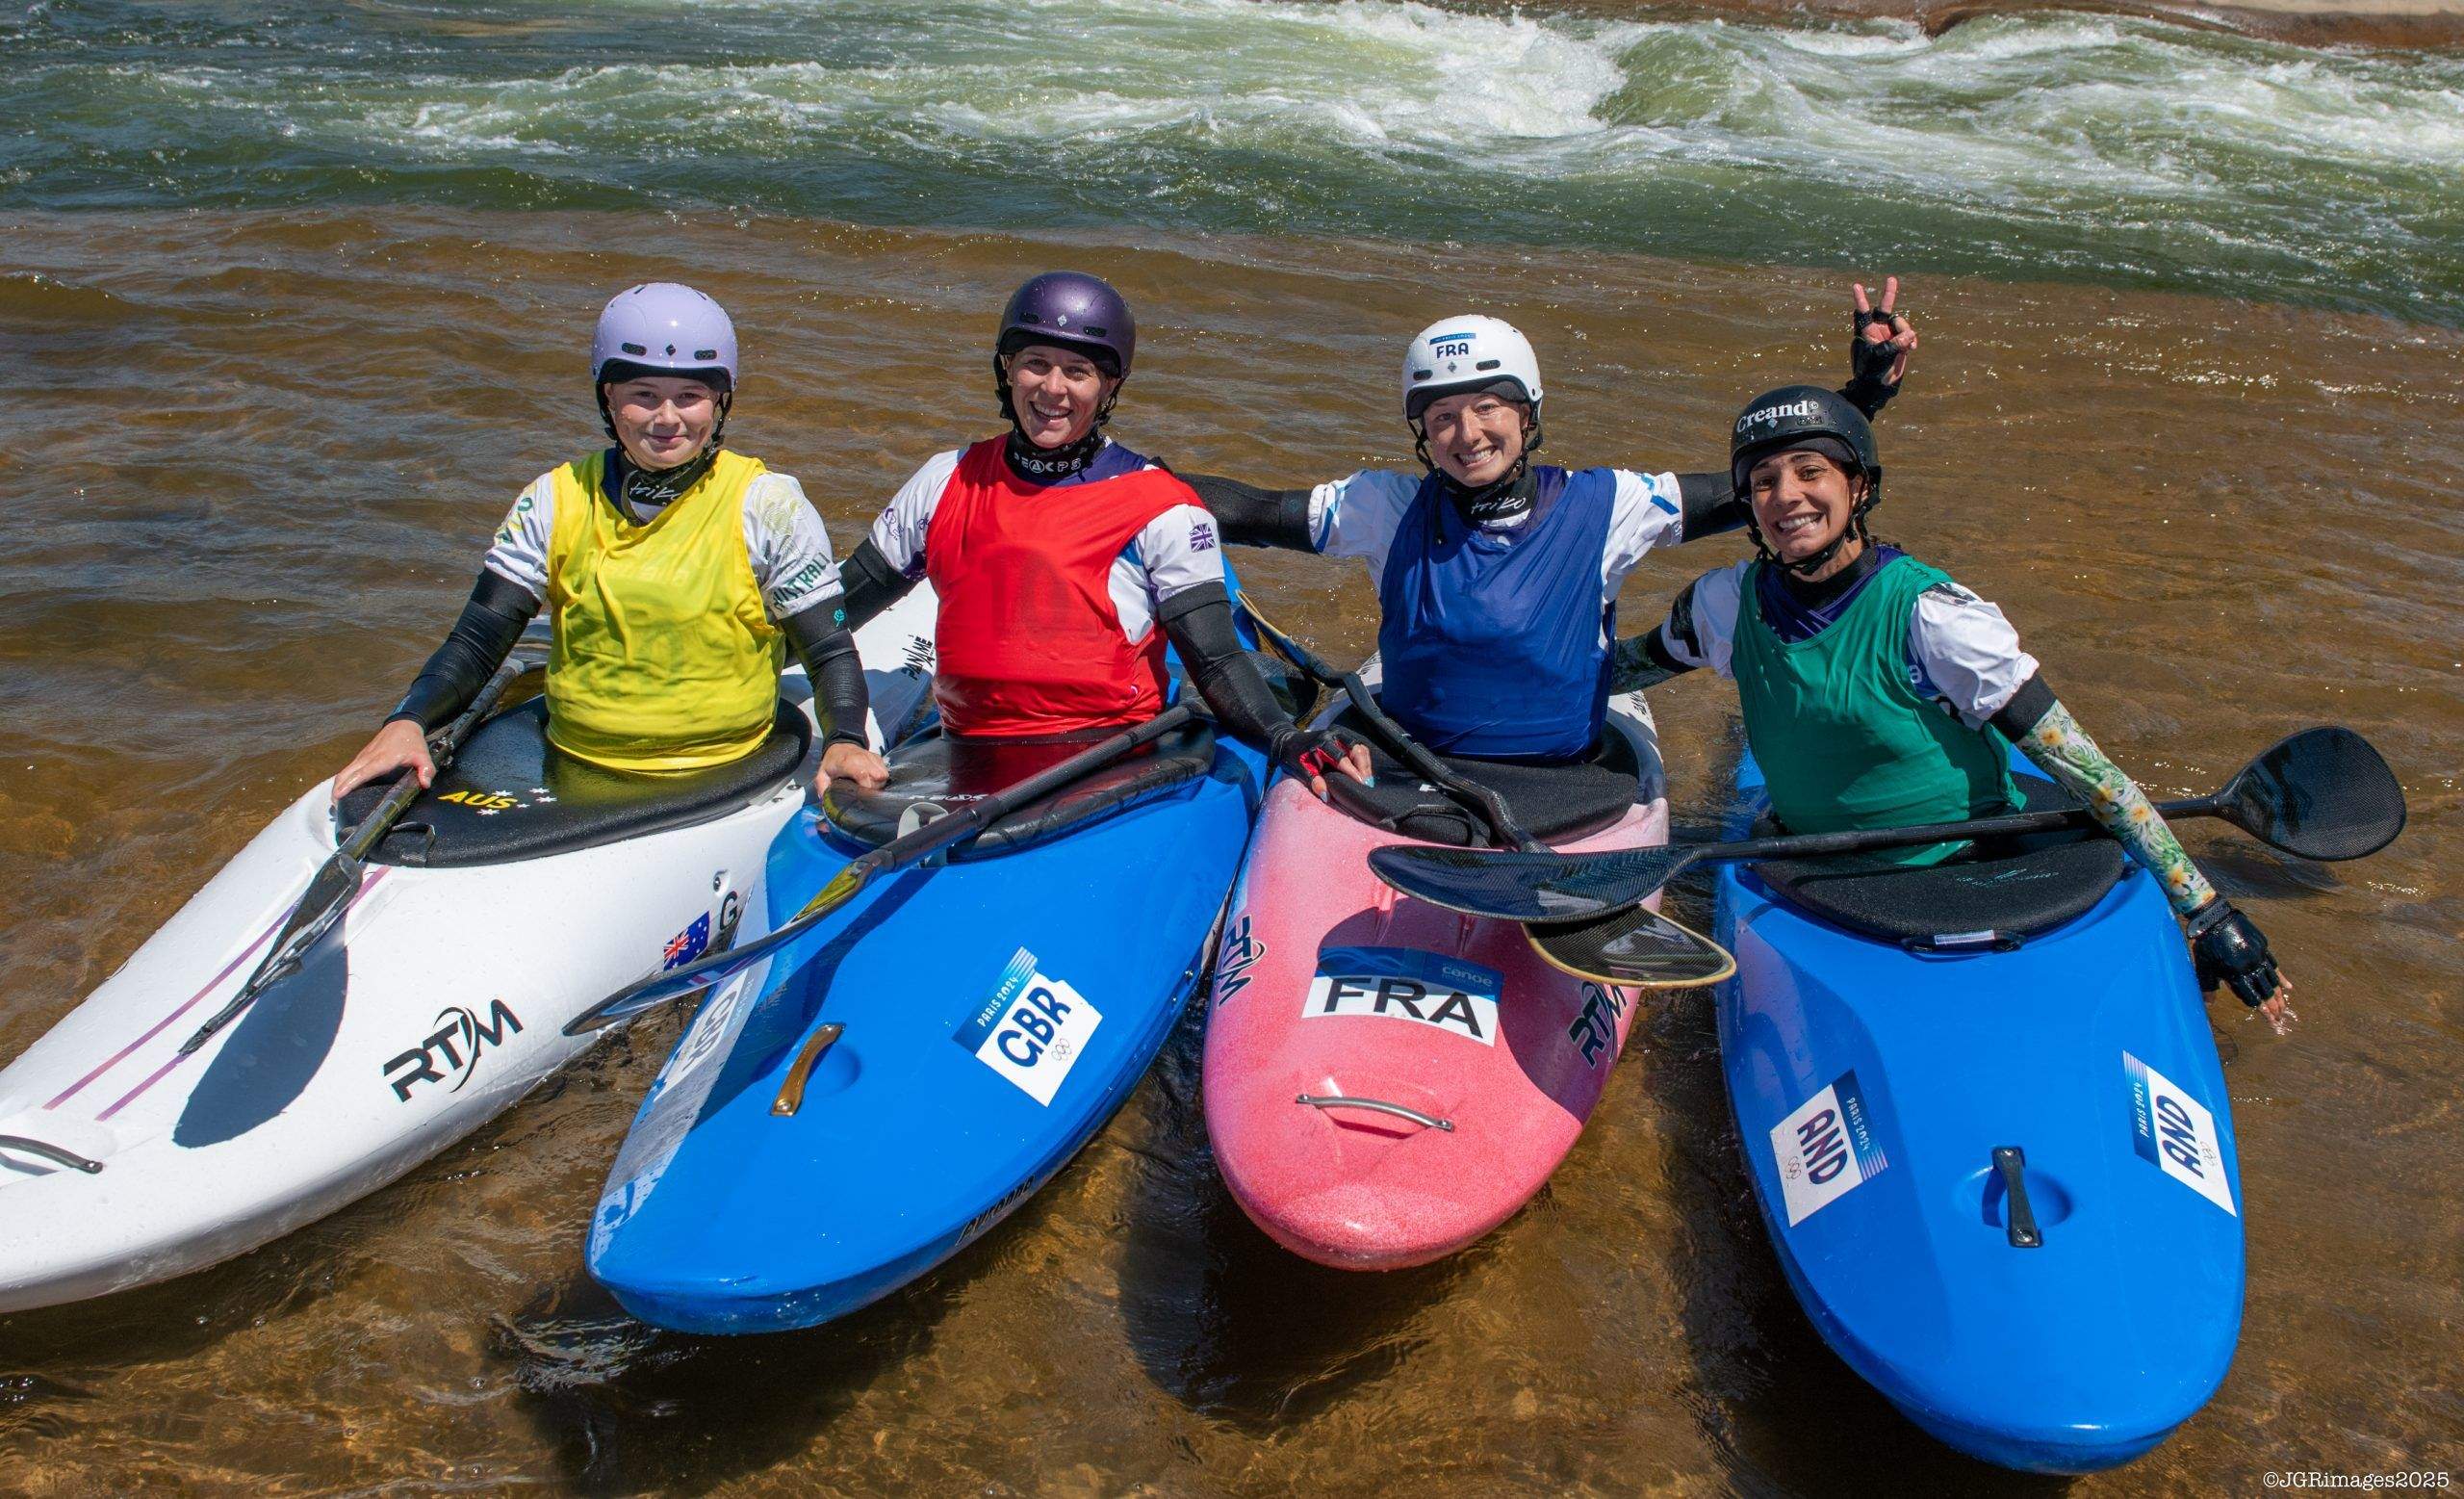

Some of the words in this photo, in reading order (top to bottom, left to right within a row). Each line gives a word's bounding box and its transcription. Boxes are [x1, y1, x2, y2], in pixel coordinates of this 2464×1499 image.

[1436, 342, 1470, 359] FRA
[1735, 400, 1809, 433] Creand
[437, 790, 518, 809] AUS
[976, 998, 1002, 1028] PARIS
[996, 974, 1019, 1001] 2024
[1442, 966, 1494, 987] canoe
[997, 986, 1072, 1068] GBR
[1322, 976, 1484, 1039] FRA
[383, 998, 524, 1103] RTM
[2133, 1080, 2146, 1109] 2024
[1796, 1108, 1848, 1185] AND
[1846, 1097, 1863, 1126] PARIS
[1855, 1124, 1871, 1151] 2024
[2136, 1107, 2150, 1139] PARIS
[2155, 1094, 2205, 1179] AND
